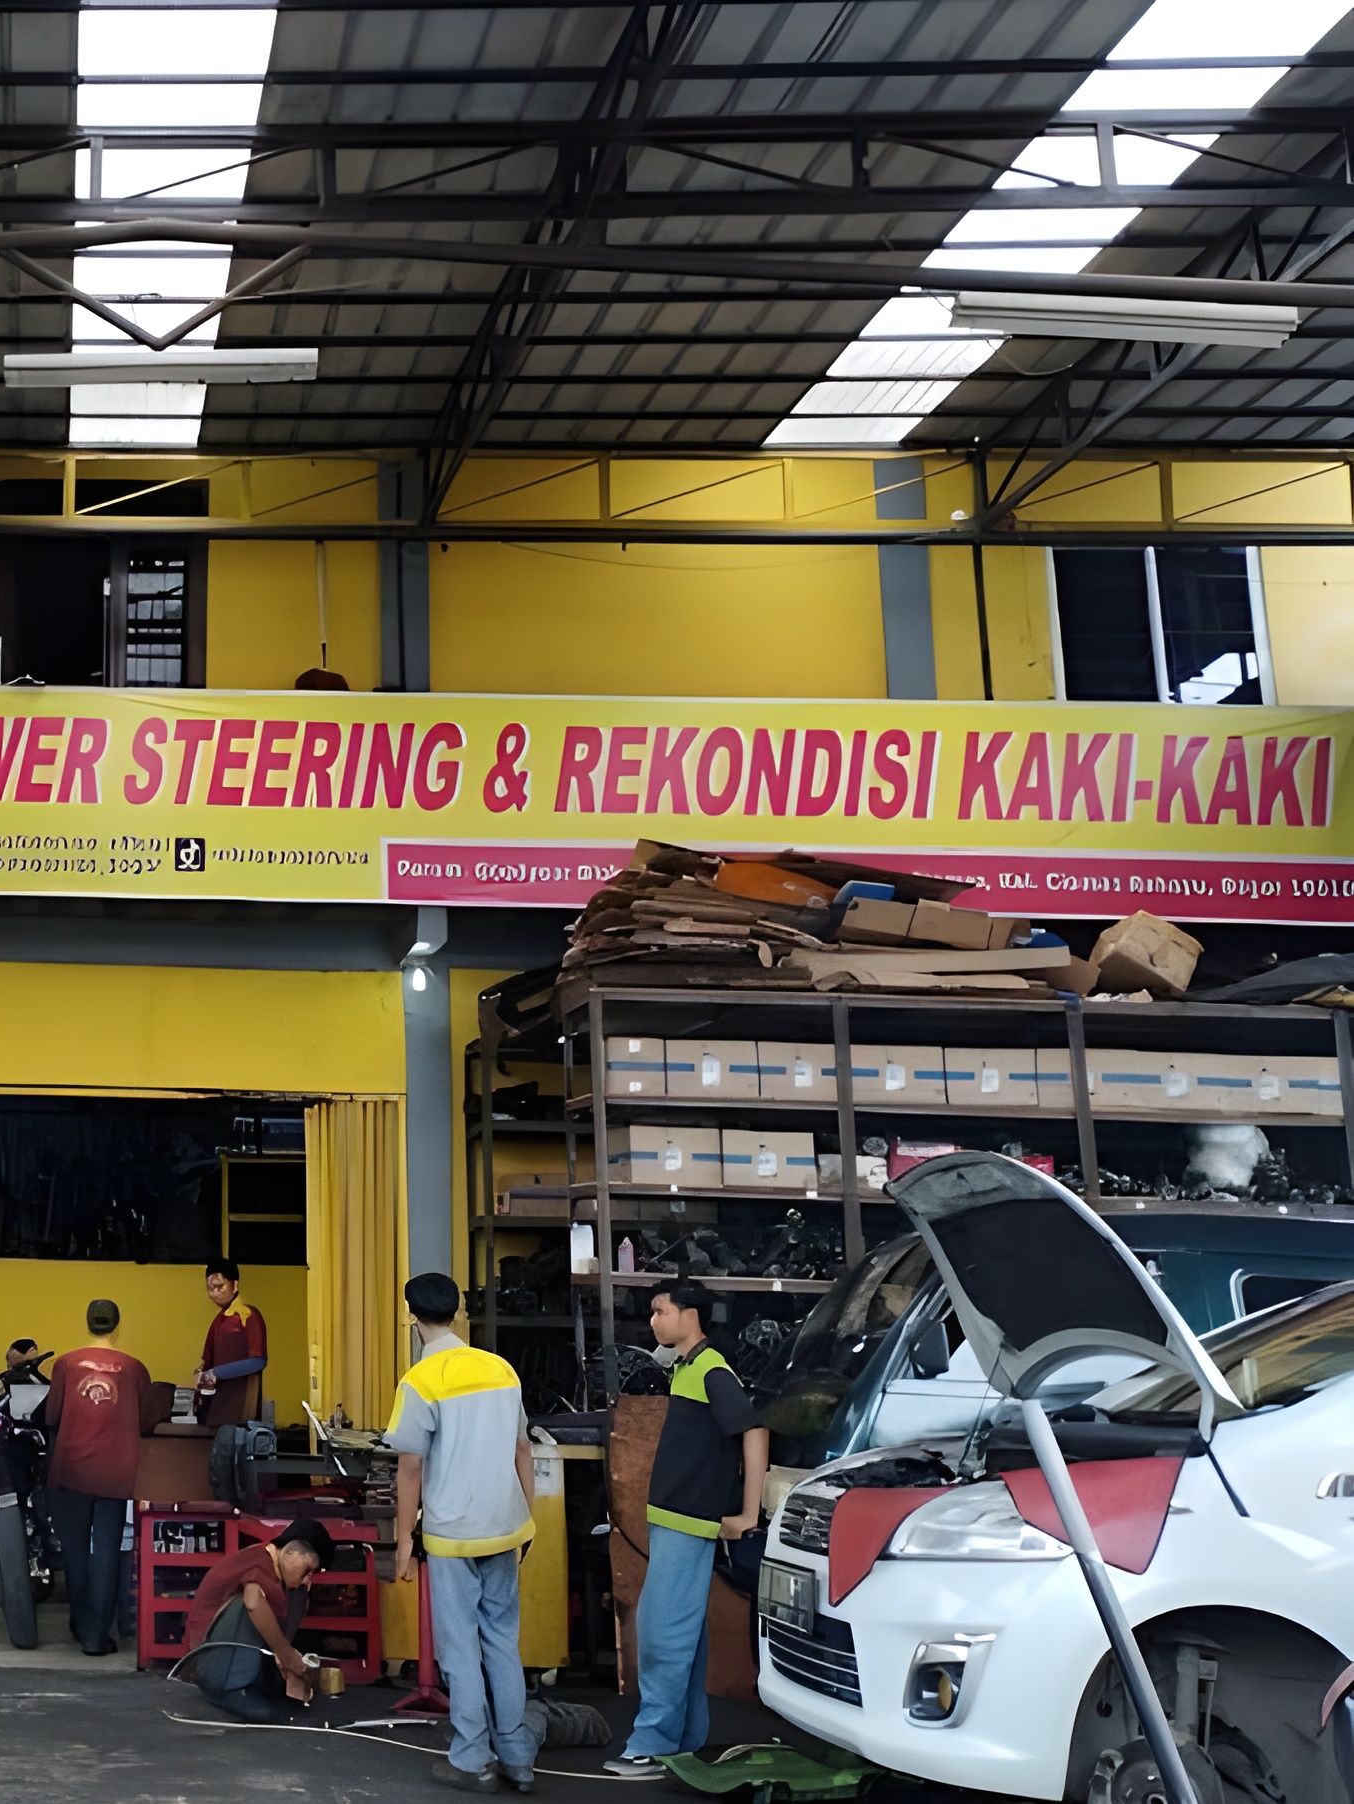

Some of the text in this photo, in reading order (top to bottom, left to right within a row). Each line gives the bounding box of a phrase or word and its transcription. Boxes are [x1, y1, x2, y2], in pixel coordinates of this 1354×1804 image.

[125, 718, 463, 811] STEERING
[484, 724, 529, 813] &
[555, 726, 938, 820] REKONDISI
[958, 732, 1331, 827] KAKI-KAKI
